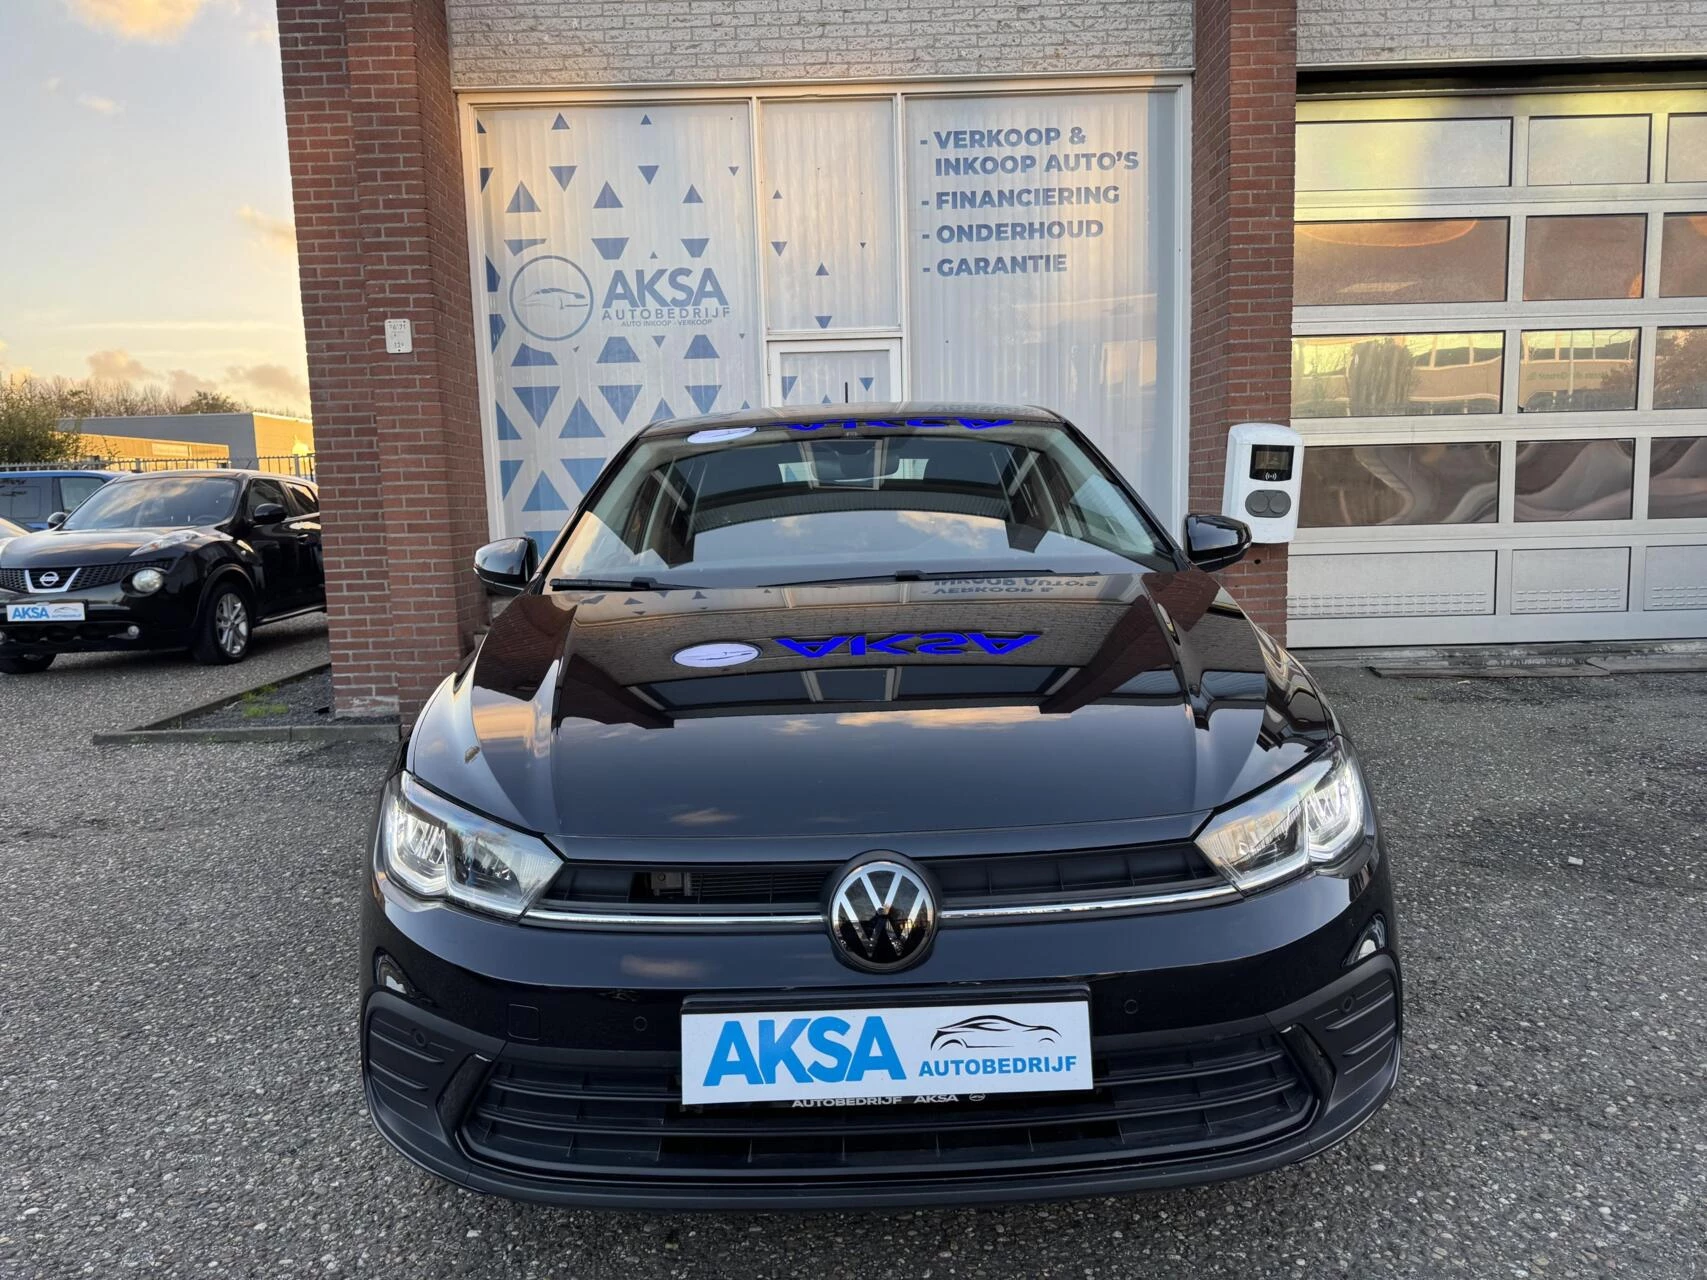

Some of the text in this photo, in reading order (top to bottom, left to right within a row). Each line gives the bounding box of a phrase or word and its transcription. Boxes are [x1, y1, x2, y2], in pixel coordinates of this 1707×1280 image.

[933, 127, 1061, 150] VERKOOP
[1068, 126, 1086, 145] &
[935, 151, 1139, 176] INKOOP AUTO'S
[936, 185, 1120, 210] FINANCIERING
[936, 219, 1104, 244] ONDERHOUD
[937, 254, 1067, 277] GARANTIE
[602, 267, 729, 309] AKSA
[602, 307, 730, 321] AUTOBEDRIJF
[621, 320, 642, 328] AUTO
[643, 320, 672, 328] INKOOP
[678, 318, 712, 327] VERKOOP
[12, 606, 50, 619] AKSA
[702, 1015, 1078, 1087] AKSA AUTOBEDRIJF
[791, 1094, 960, 1108] AUTOBEDRIJF AKSA
